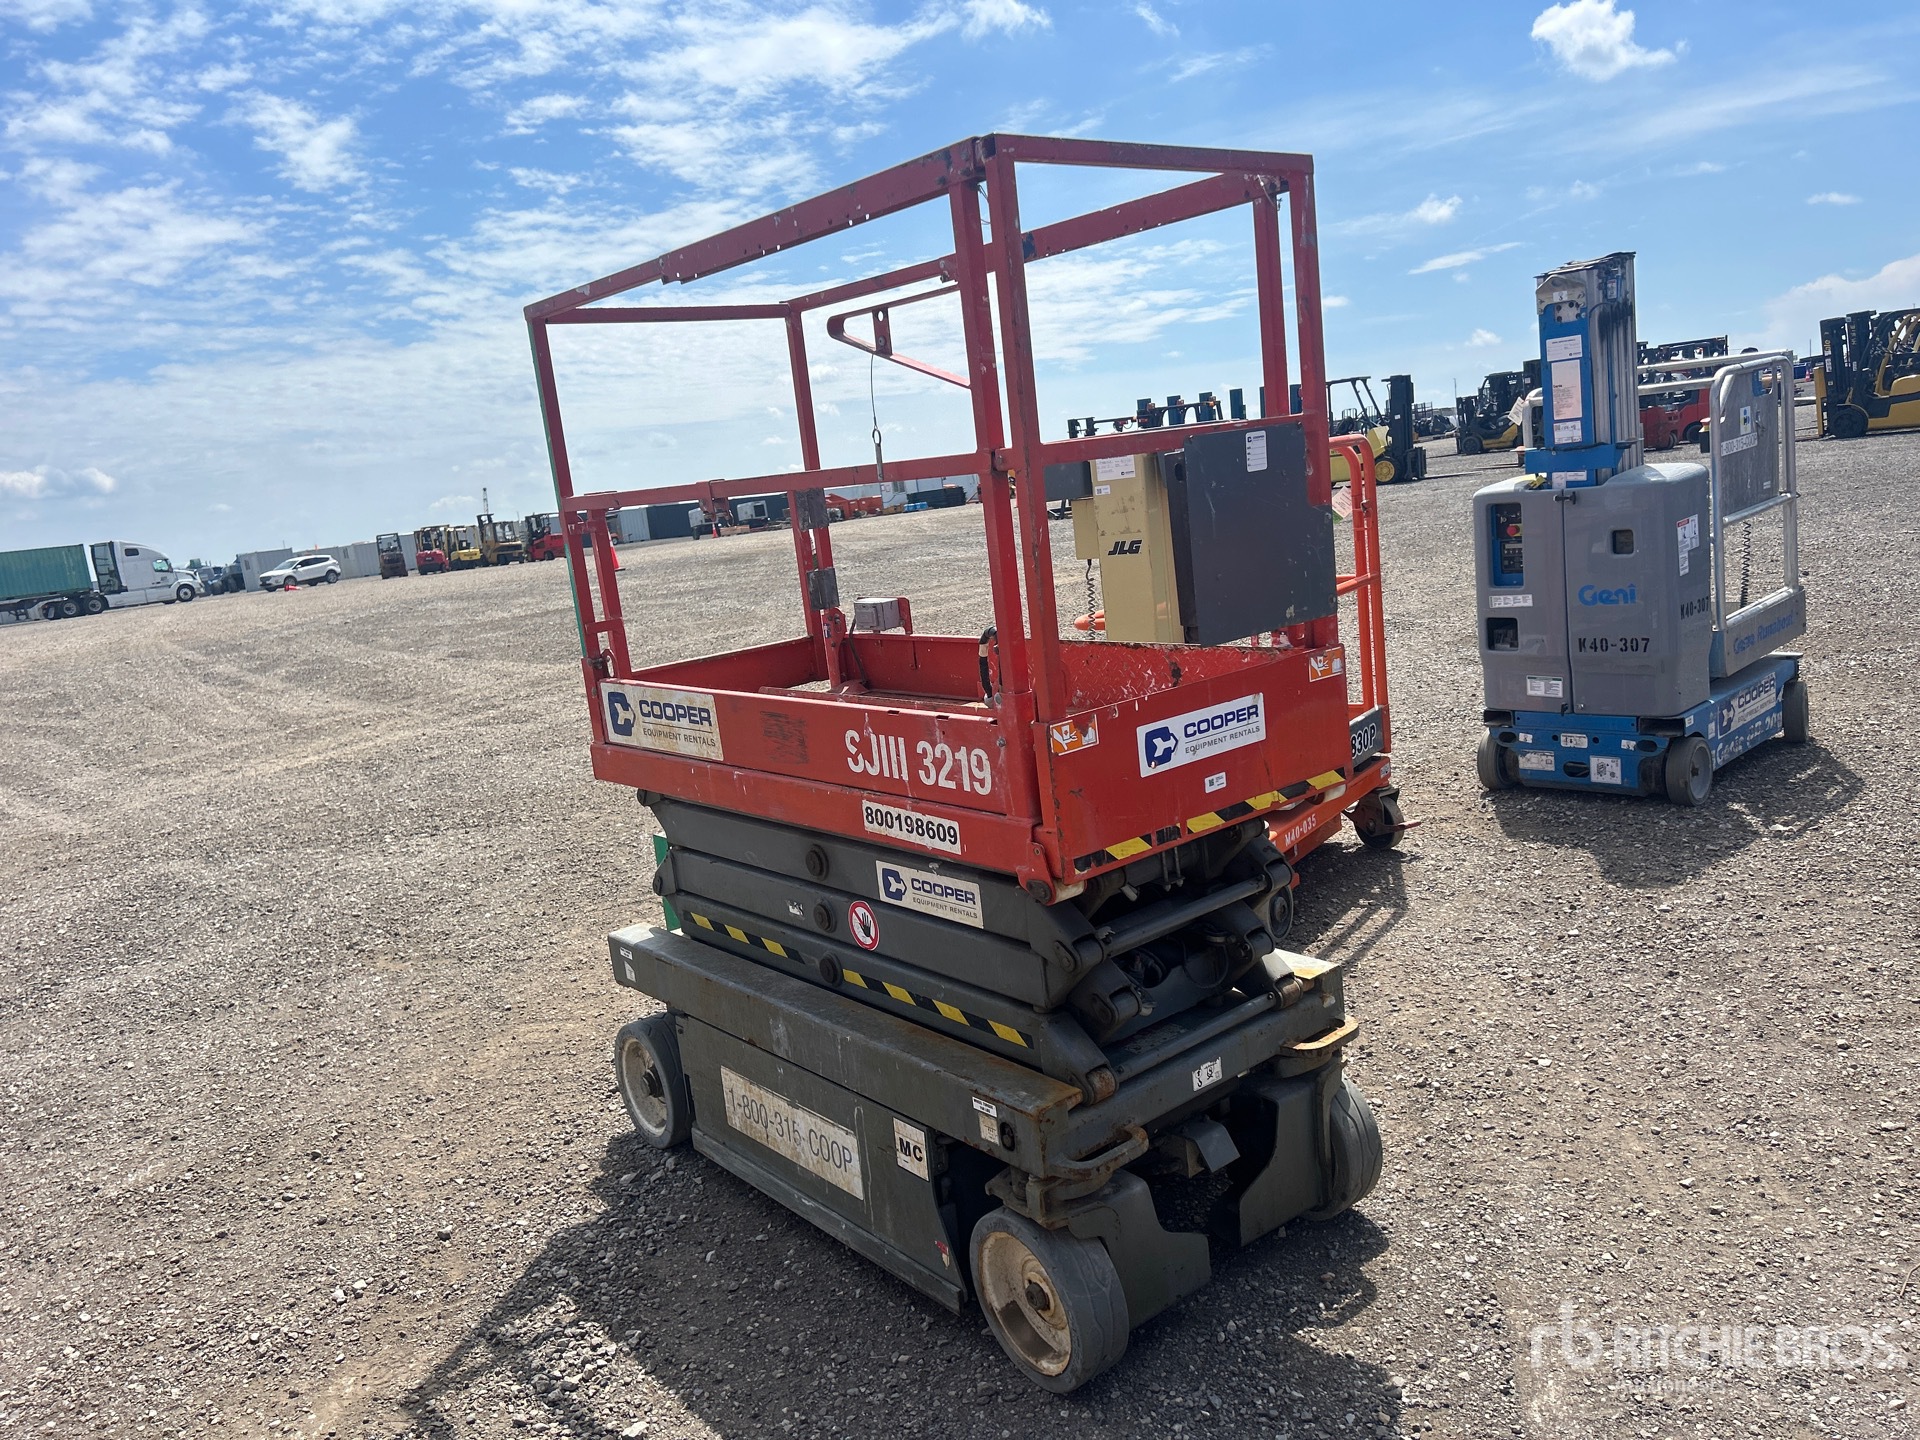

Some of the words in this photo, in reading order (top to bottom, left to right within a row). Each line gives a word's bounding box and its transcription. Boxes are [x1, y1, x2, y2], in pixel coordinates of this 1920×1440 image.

[1108, 539, 1142, 556] JLG
[1578, 637, 1650, 653] K40-307
[1737, 678, 1776, 707] COOPER
[639, 700, 714, 727] COOPER
[1183, 704, 1260, 738] COOPER
[643, 728, 682, 741] EQUIPMENT
[684, 734, 716, 747] RENTALS
[1185, 735, 1227, 754] EQUIPMENT
[1229, 725, 1261, 742] RENTALS
[844, 729, 909, 781] SJIII
[916, 740, 992, 796] 3219
[865, 806, 958, 846] 800198609
[1284, 813, 1317, 847] M40-035
[911, 878, 977, 905] COOPER
[912, 897, 948, 911] EQUIPMENT
[949, 905, 978, 919] RENTALS
[728, 1087, 853, 1173] 1-800-315-COOP
[899, 1136, 923, 1162] MC
